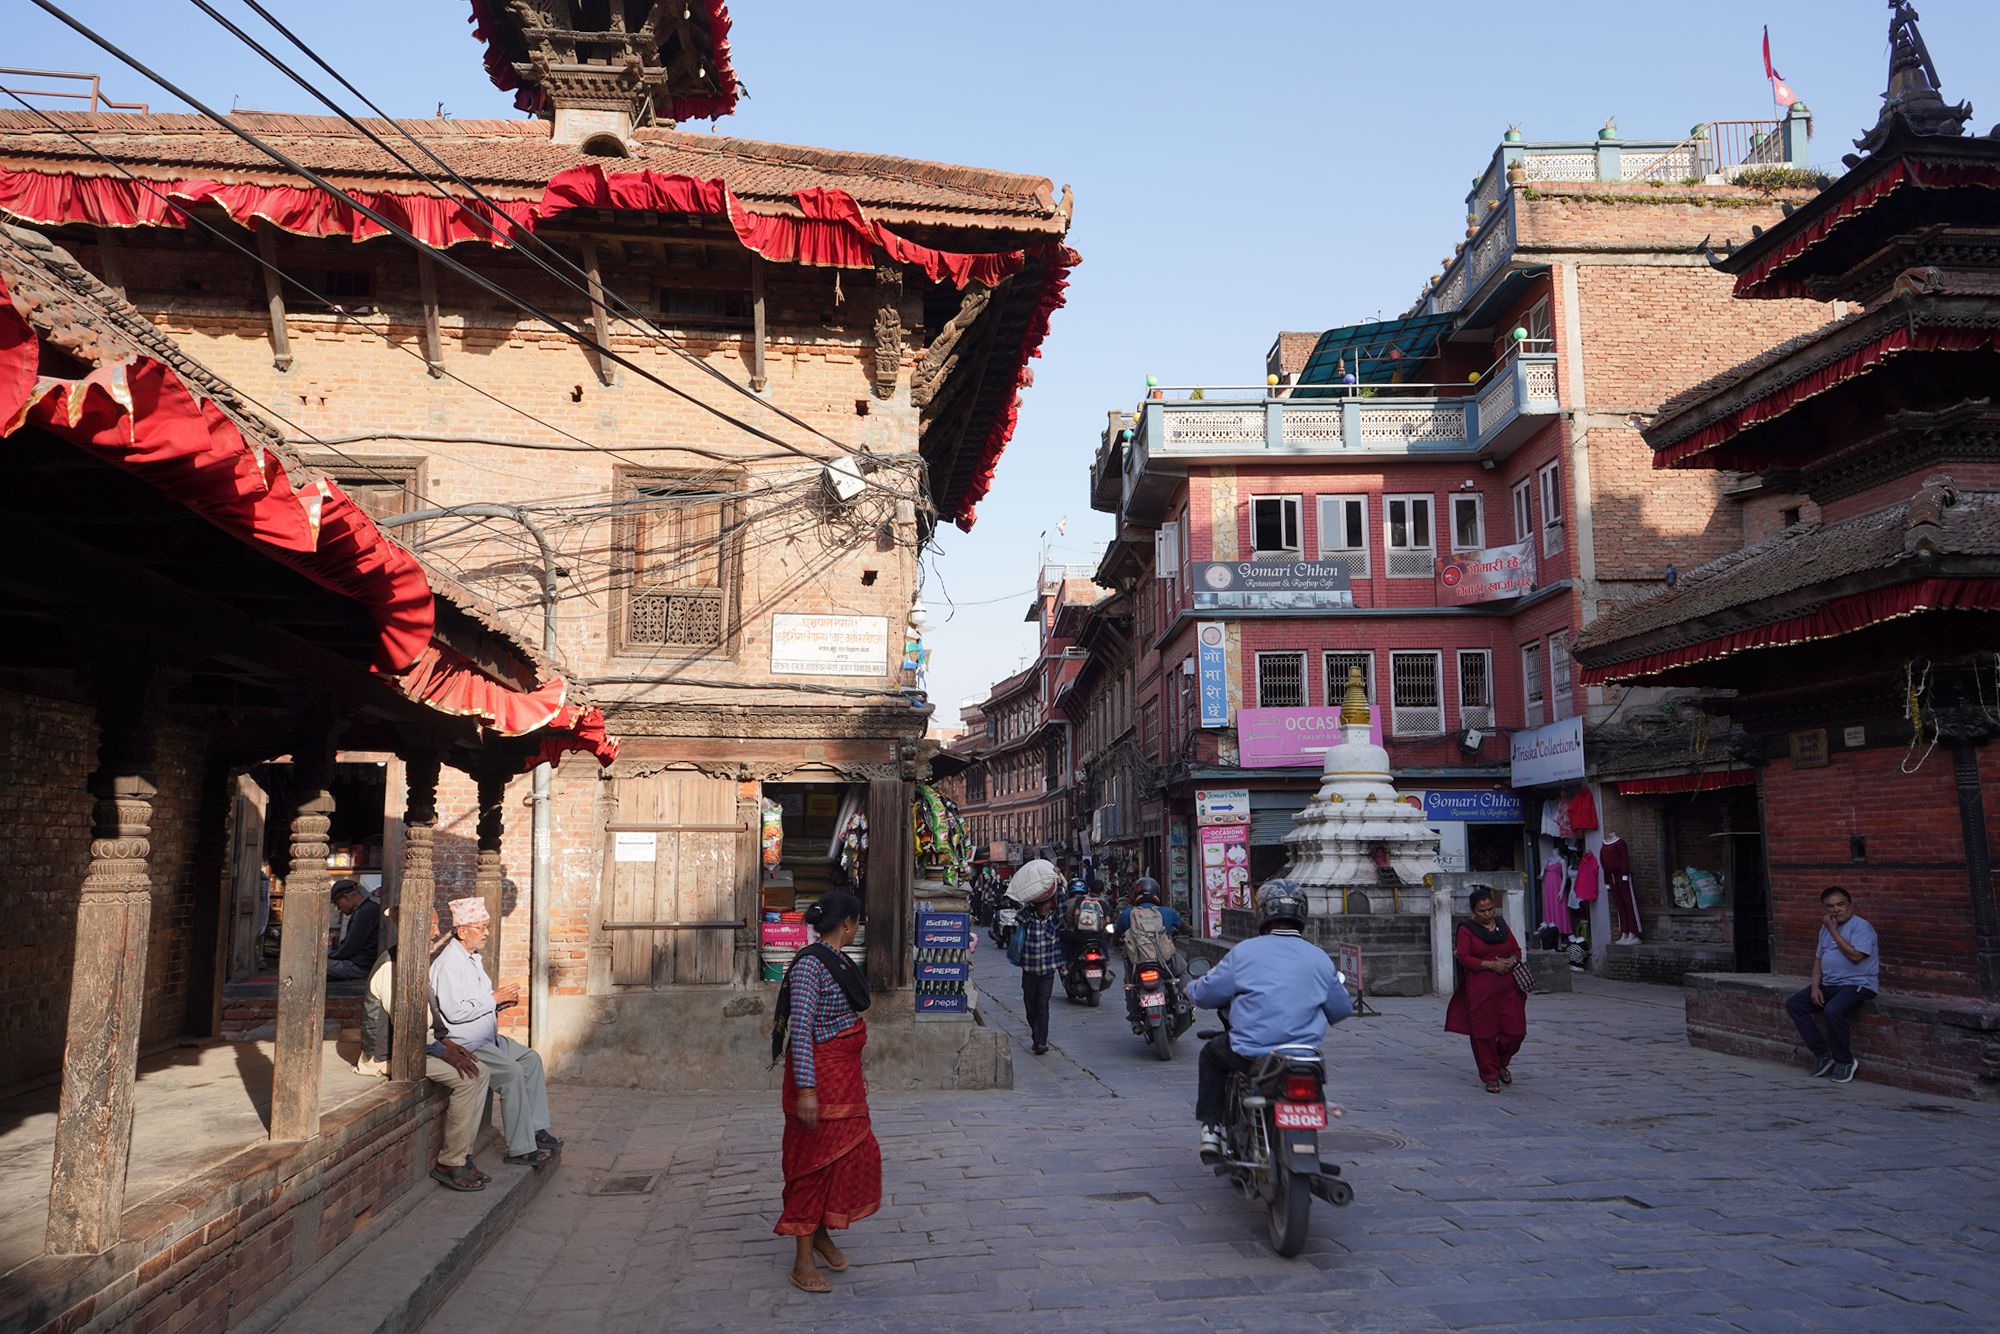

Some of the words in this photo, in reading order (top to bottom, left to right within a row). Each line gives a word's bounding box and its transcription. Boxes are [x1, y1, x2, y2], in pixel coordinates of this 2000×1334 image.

[1237, 562, 1291, 577] Gomari
[1294, 562, 1338, 577] Chhen
[1245, 578, 1281, 588] Restaurant
[1282, 578, 1290, 587] &
[1291, 578, 1319, 589] Rooftop
[1319, 577, 1334, 589] Cafe
[1285, 716, 1341, 731] OCCASI
[1539, 735, 1577, 758] Collection
[1428, 792, 1477, 808] Gomari
[1480, 792, 1520, 807] Chhen
[1451, 808, 1479, 817] Restaurant
[932, 935, 961, 943] PEPSI
[932, 967, 960, 975] PEPSI
